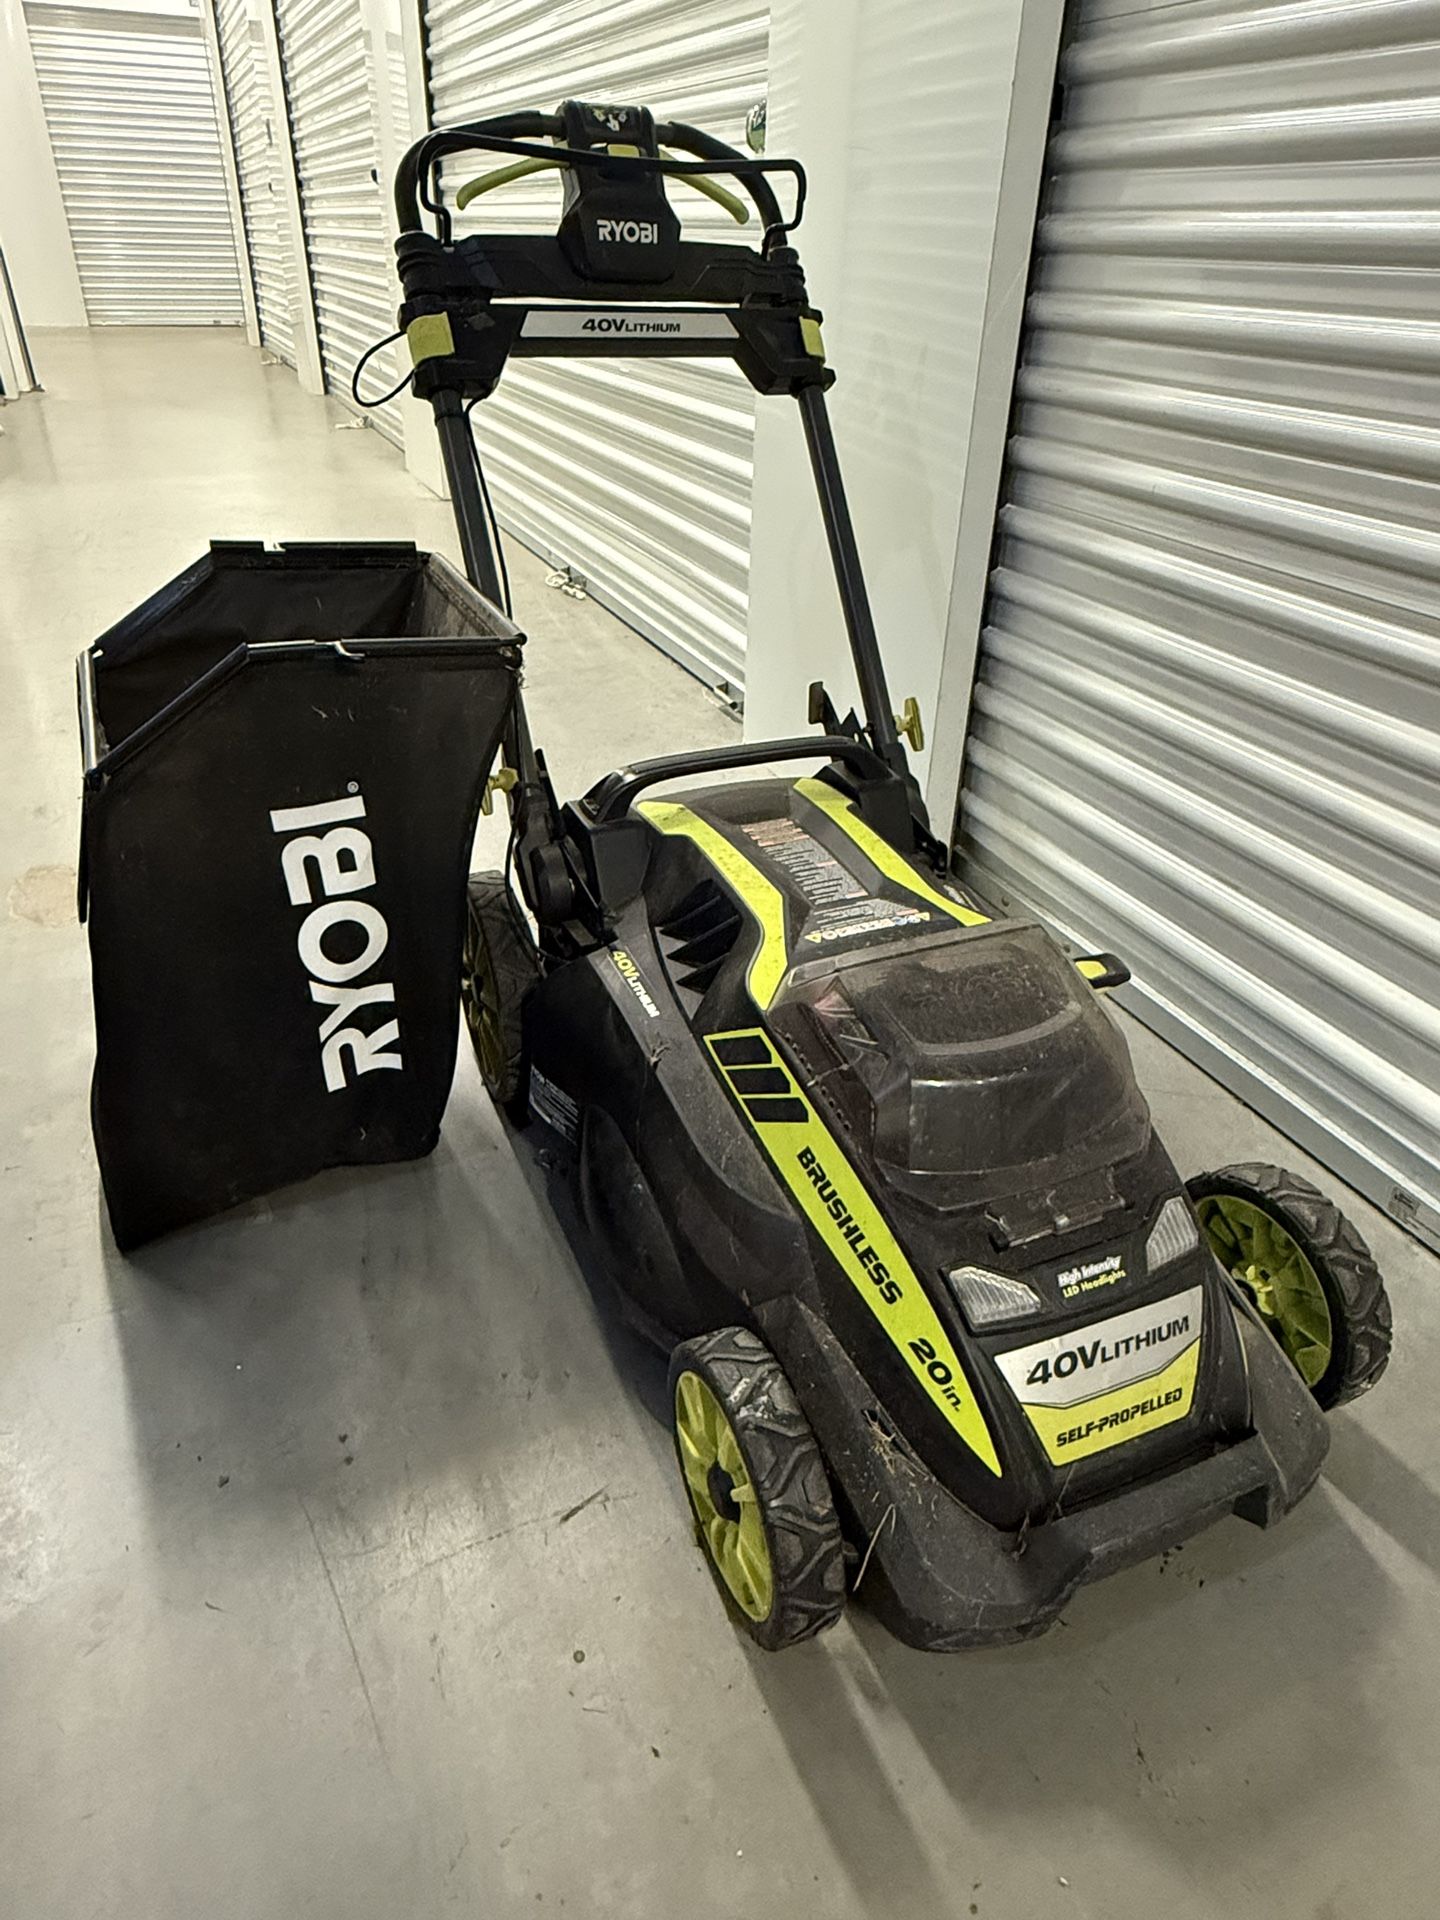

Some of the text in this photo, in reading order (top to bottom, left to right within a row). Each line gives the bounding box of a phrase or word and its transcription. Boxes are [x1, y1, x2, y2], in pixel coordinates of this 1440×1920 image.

[596, 219, 658, 245] RYOBI
[796, 1145, 903, 1305] BRUSHLESS
[1057, 1267, 1082, 1288] High
[1056, 1387, 1182, 1447] SELF-PROPELLED
